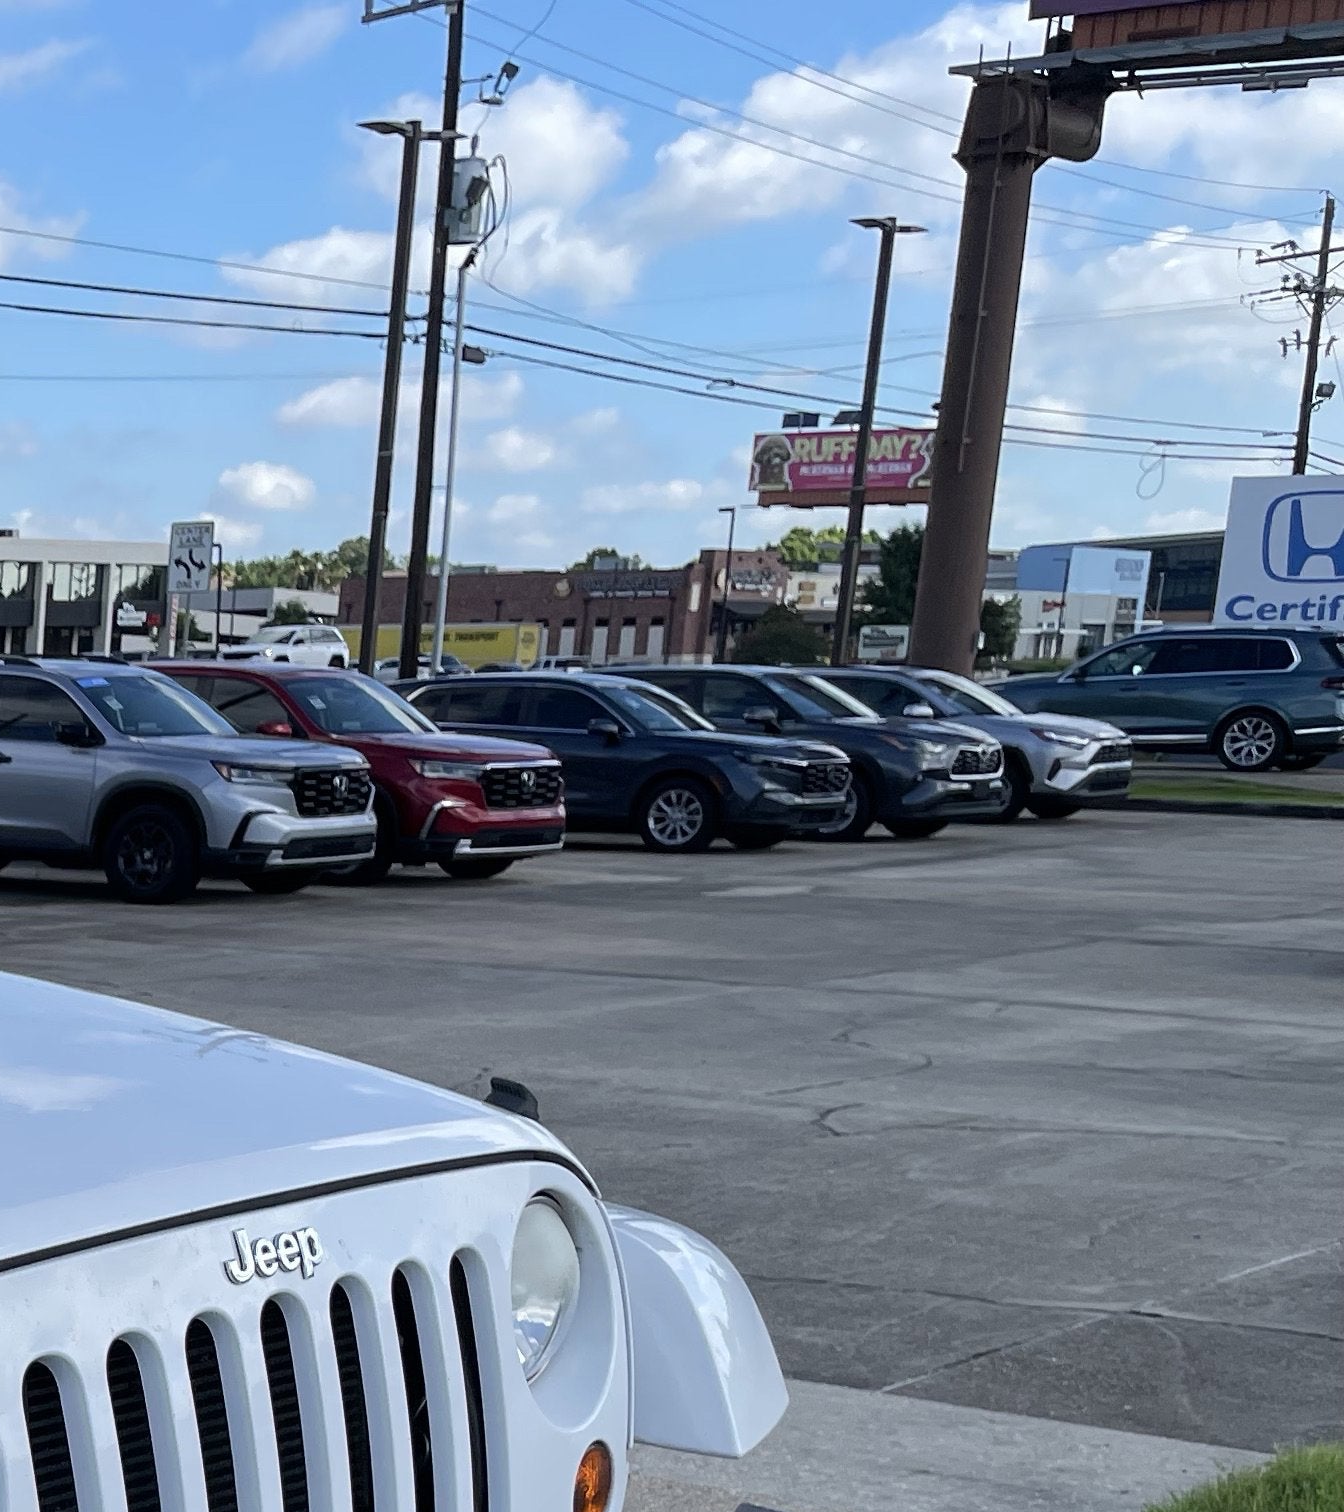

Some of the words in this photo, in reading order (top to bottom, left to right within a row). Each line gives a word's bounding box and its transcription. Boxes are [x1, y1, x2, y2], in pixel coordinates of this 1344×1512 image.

[793, 435, 858, 464] RUFF
[174, 525, 211, 536] CENTER
[178, 535, 204, 546] LANE
[175, 579, 201, 589] ONLY
[223, 1226, 324, 1285] Jeep
